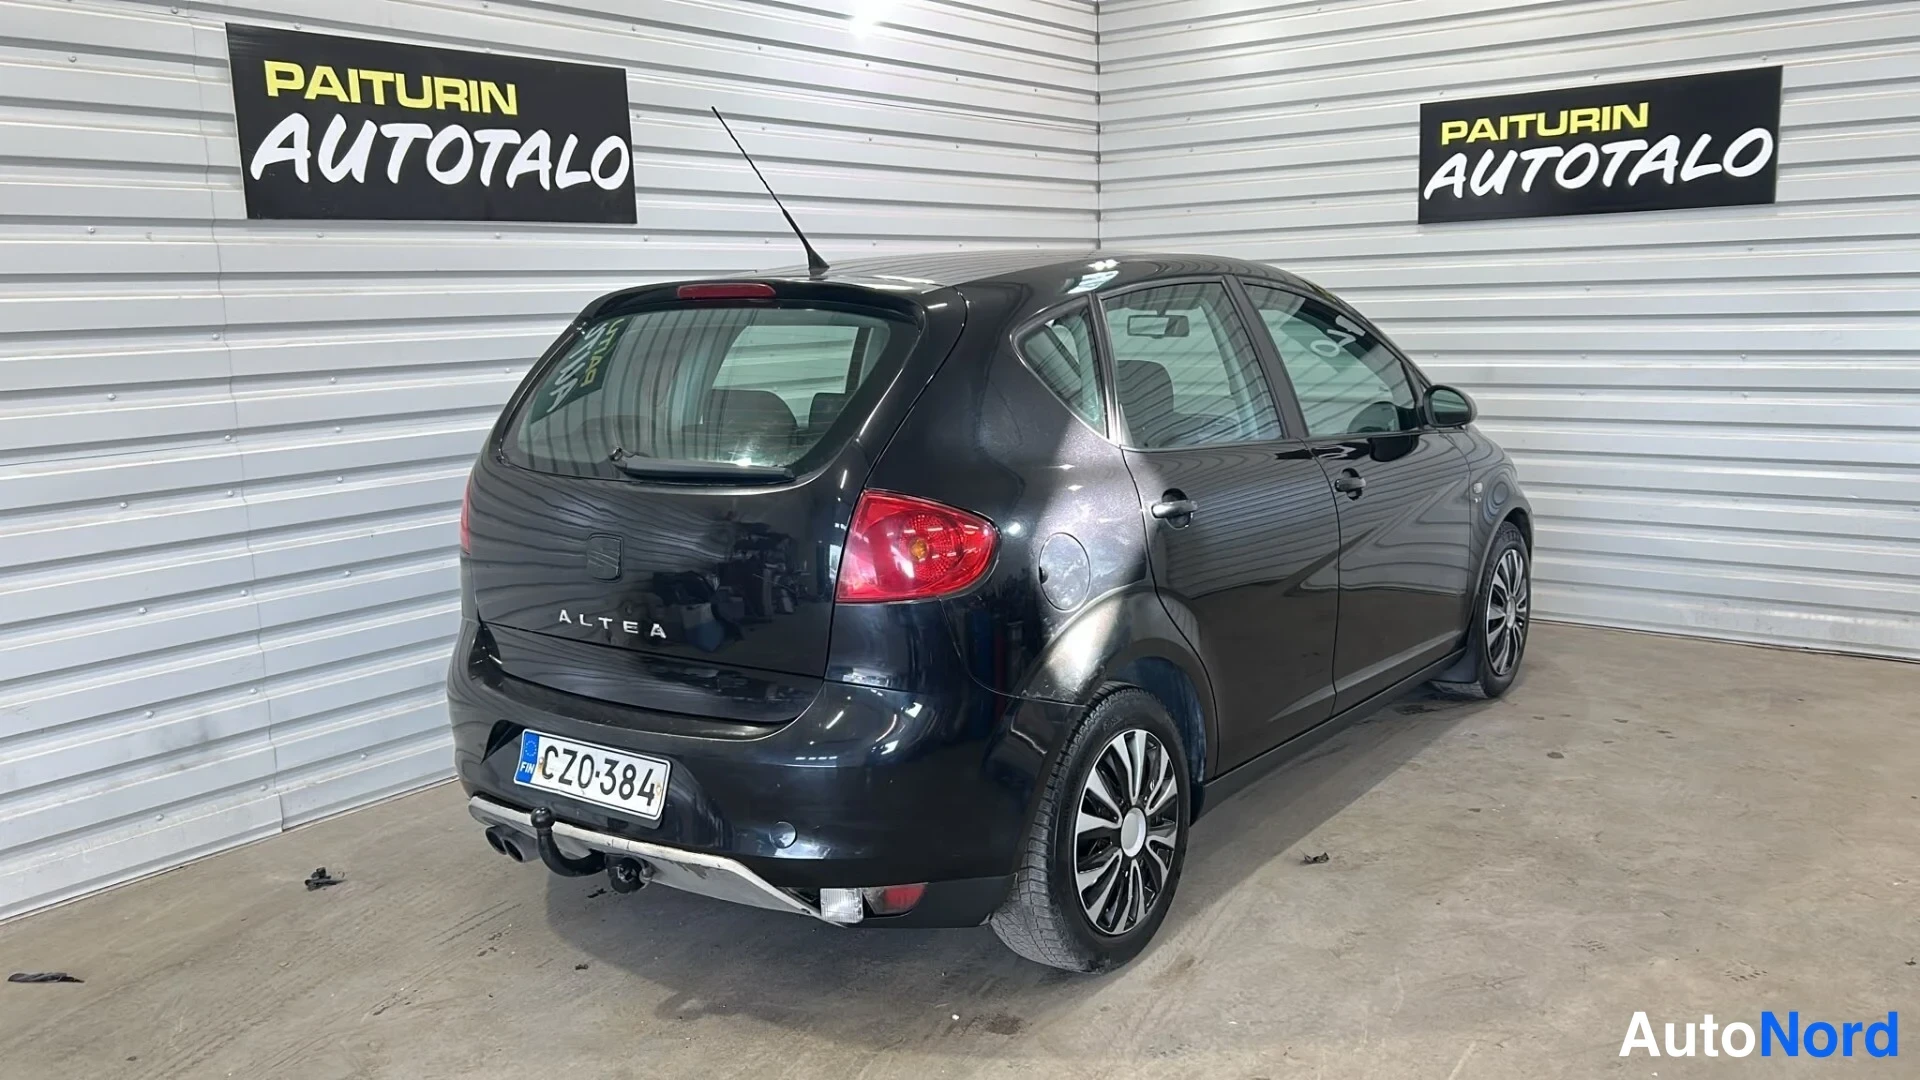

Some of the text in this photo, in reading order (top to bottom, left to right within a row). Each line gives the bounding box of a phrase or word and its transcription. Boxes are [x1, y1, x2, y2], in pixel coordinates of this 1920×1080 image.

[264, 60, 518, 115] PAITURIN
[1441, 102, 1649, 145] PAITURIN
[250, 112, 630, 191] AUTOTALO
[1424, 127, 1774, 200] AUTOTALO
[559, 609, 667, 639] ALTEA
[520, 761, 536, 774] FIN
[541, 745, 656, 806] CZO-384
